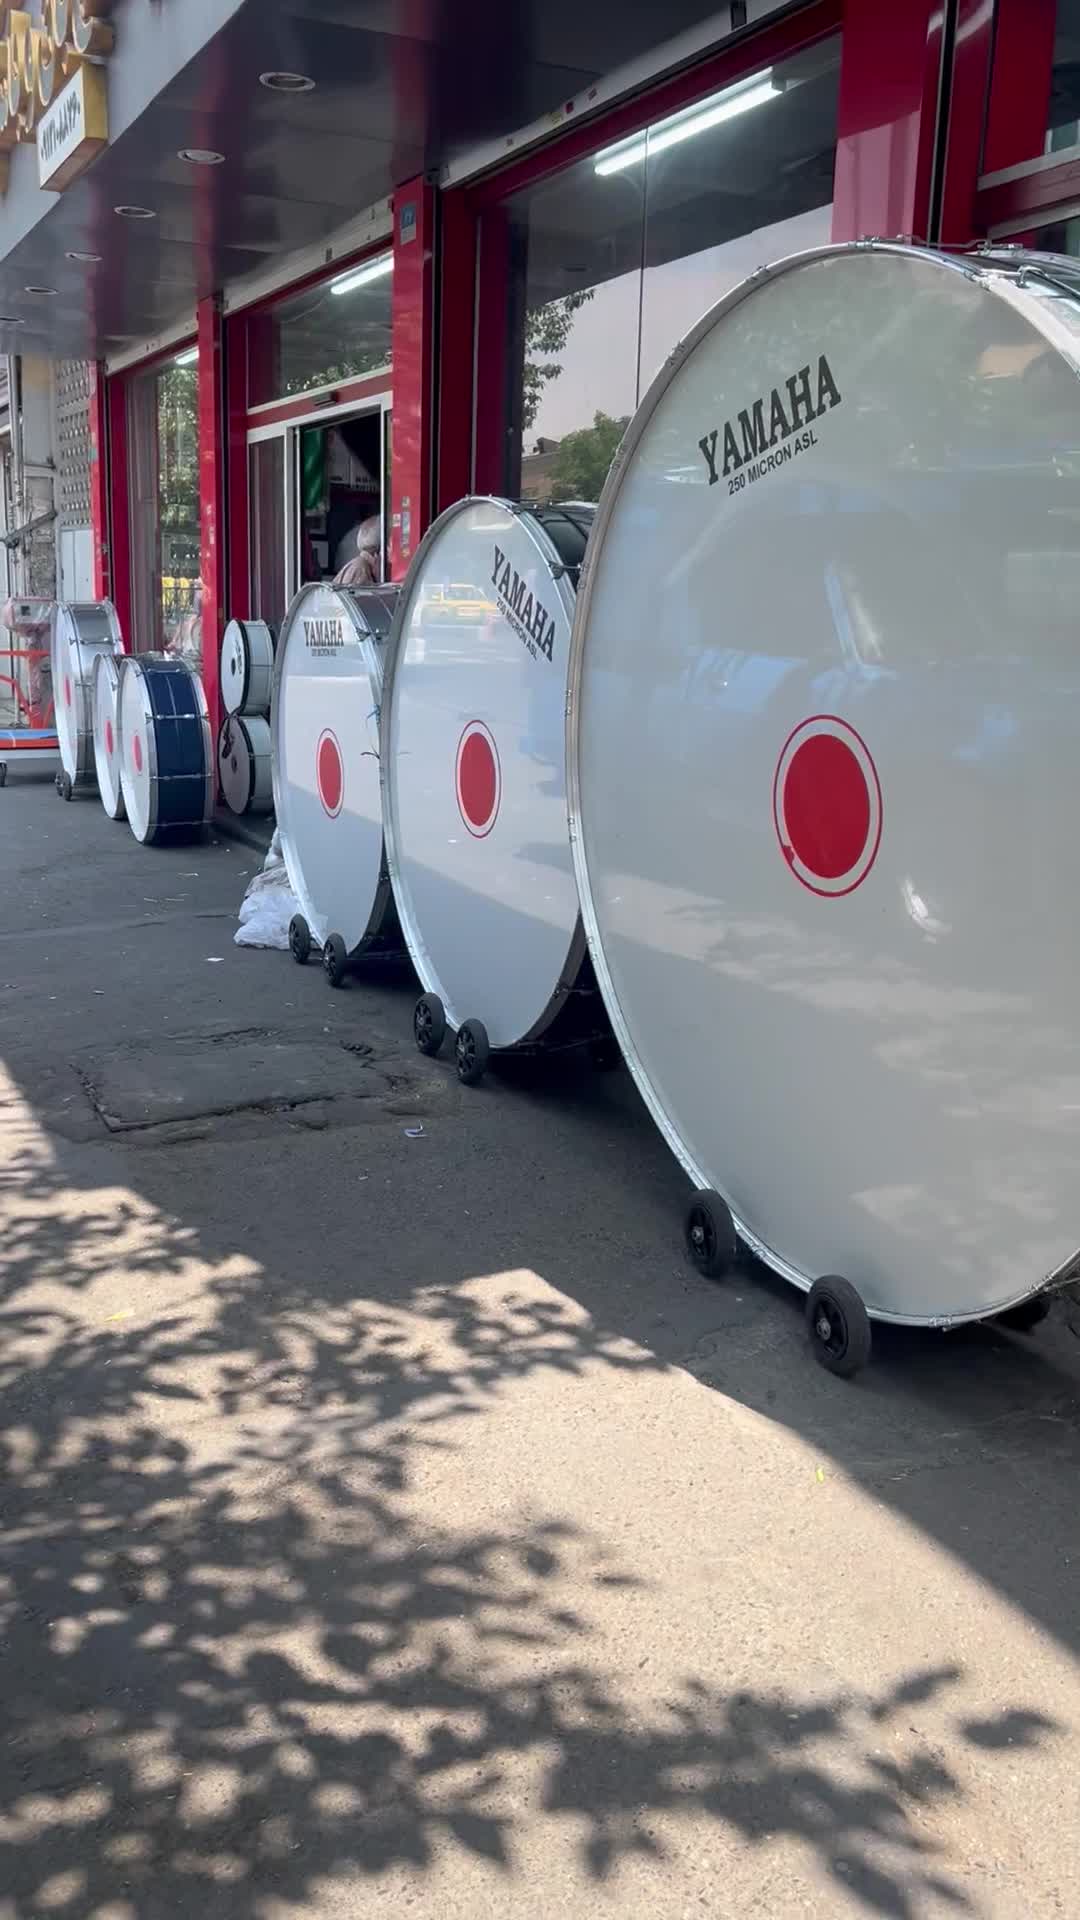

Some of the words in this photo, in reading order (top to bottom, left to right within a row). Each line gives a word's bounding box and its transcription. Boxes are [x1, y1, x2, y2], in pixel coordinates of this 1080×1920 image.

[699, 354, 842, 486] YAMAHA
[728, 473, 746, 496] 250
[748, 445, 792, 484] MICRON
[794, 429, 818, 455] ASL
[303, 620, 344, 647] YAMAHA
[491, 543, 555, 662] YAMAHA
